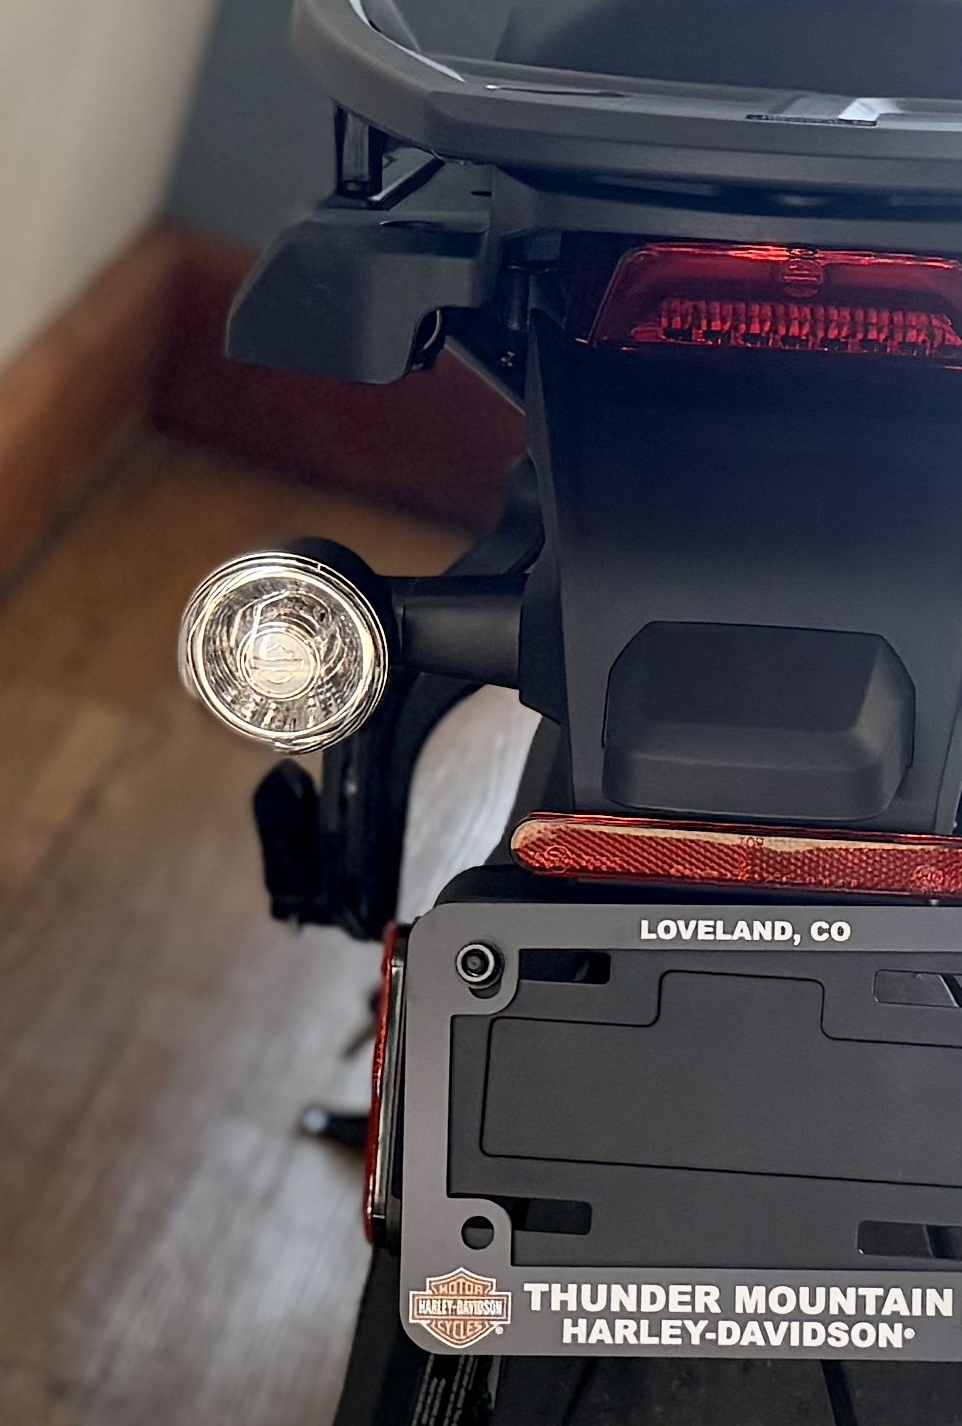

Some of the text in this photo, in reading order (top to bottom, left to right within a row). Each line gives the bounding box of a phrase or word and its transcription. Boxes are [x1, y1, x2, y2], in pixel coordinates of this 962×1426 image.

[640, 919, 852, 946] LOVELAND, CO
[438, 1278, 484, 1295] MOTOR
[418, 1298, 503, 1316] HARLEY-DAVIDSON
[523, 1282, 954, 1317] THUNDER MOUNTAIN
[437, 1319, 483, 1340] CYCLES
